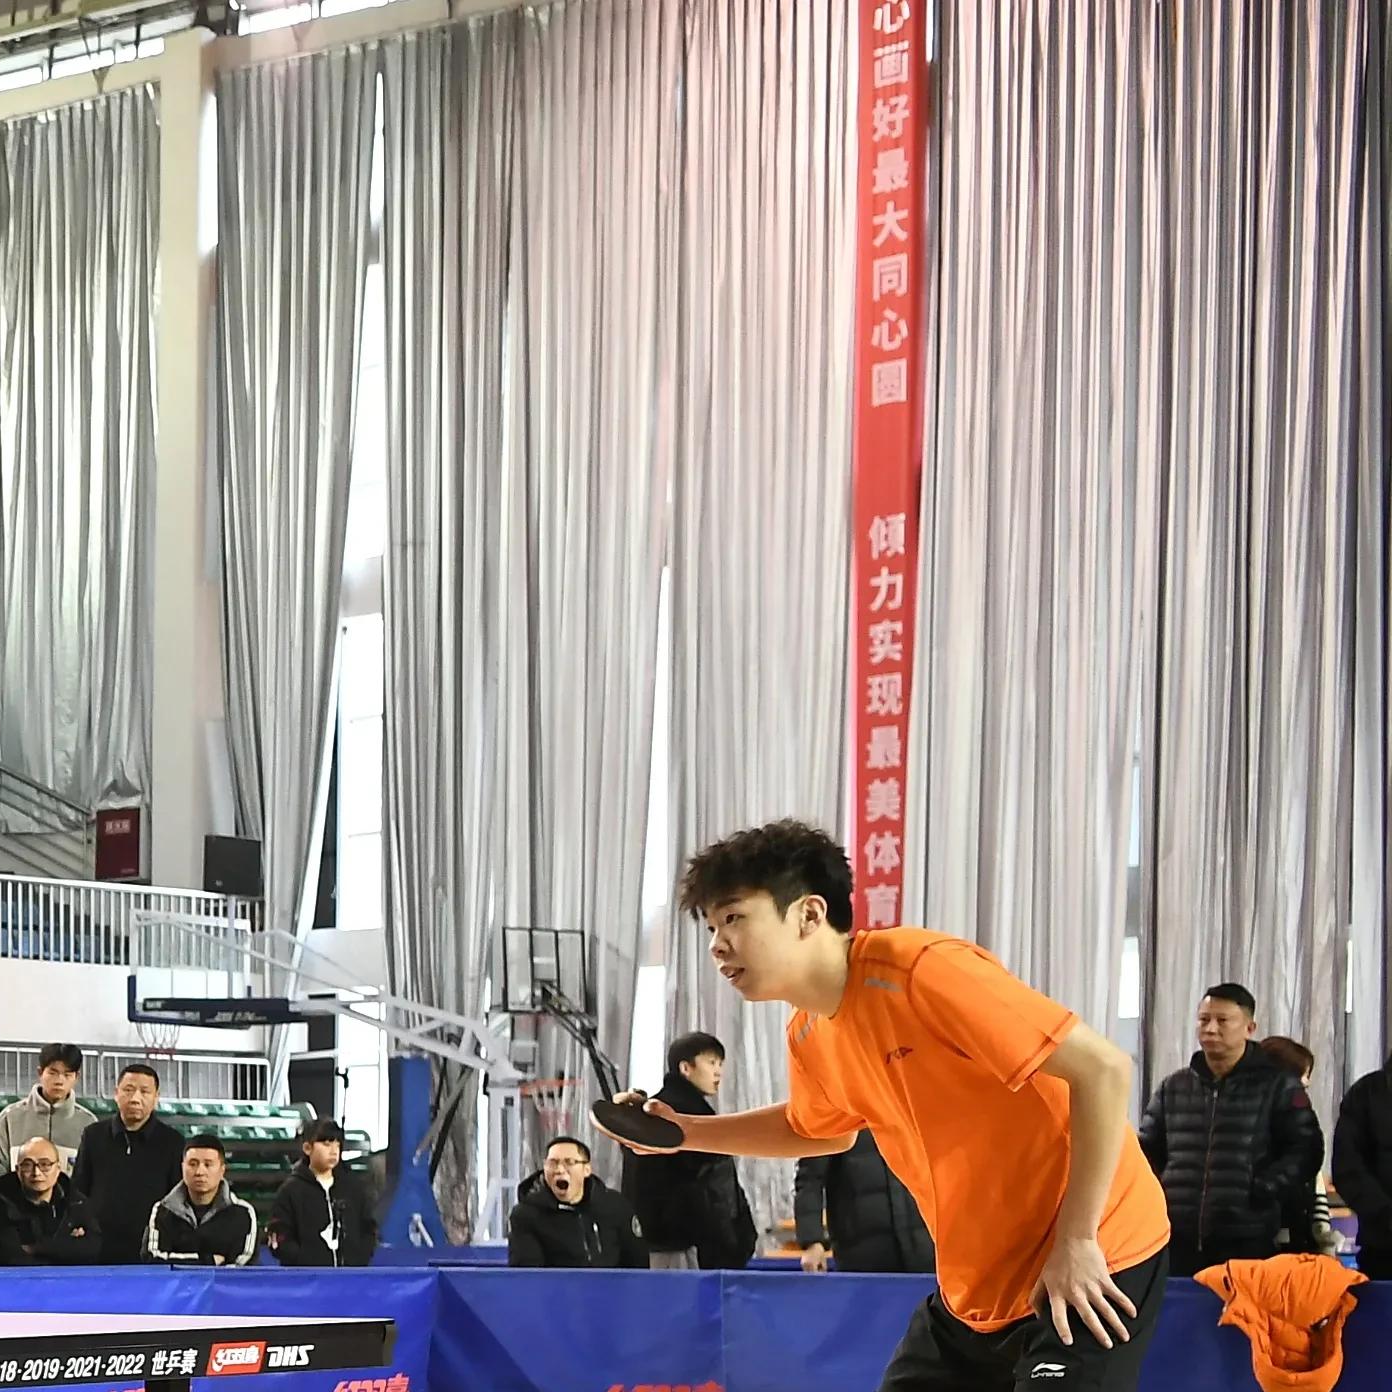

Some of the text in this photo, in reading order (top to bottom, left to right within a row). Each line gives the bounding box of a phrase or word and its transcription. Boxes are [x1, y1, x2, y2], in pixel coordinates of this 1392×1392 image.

[151, 1349, 199, 1376] 世乒赛
[266, 1345, 315, 1367] DHS
